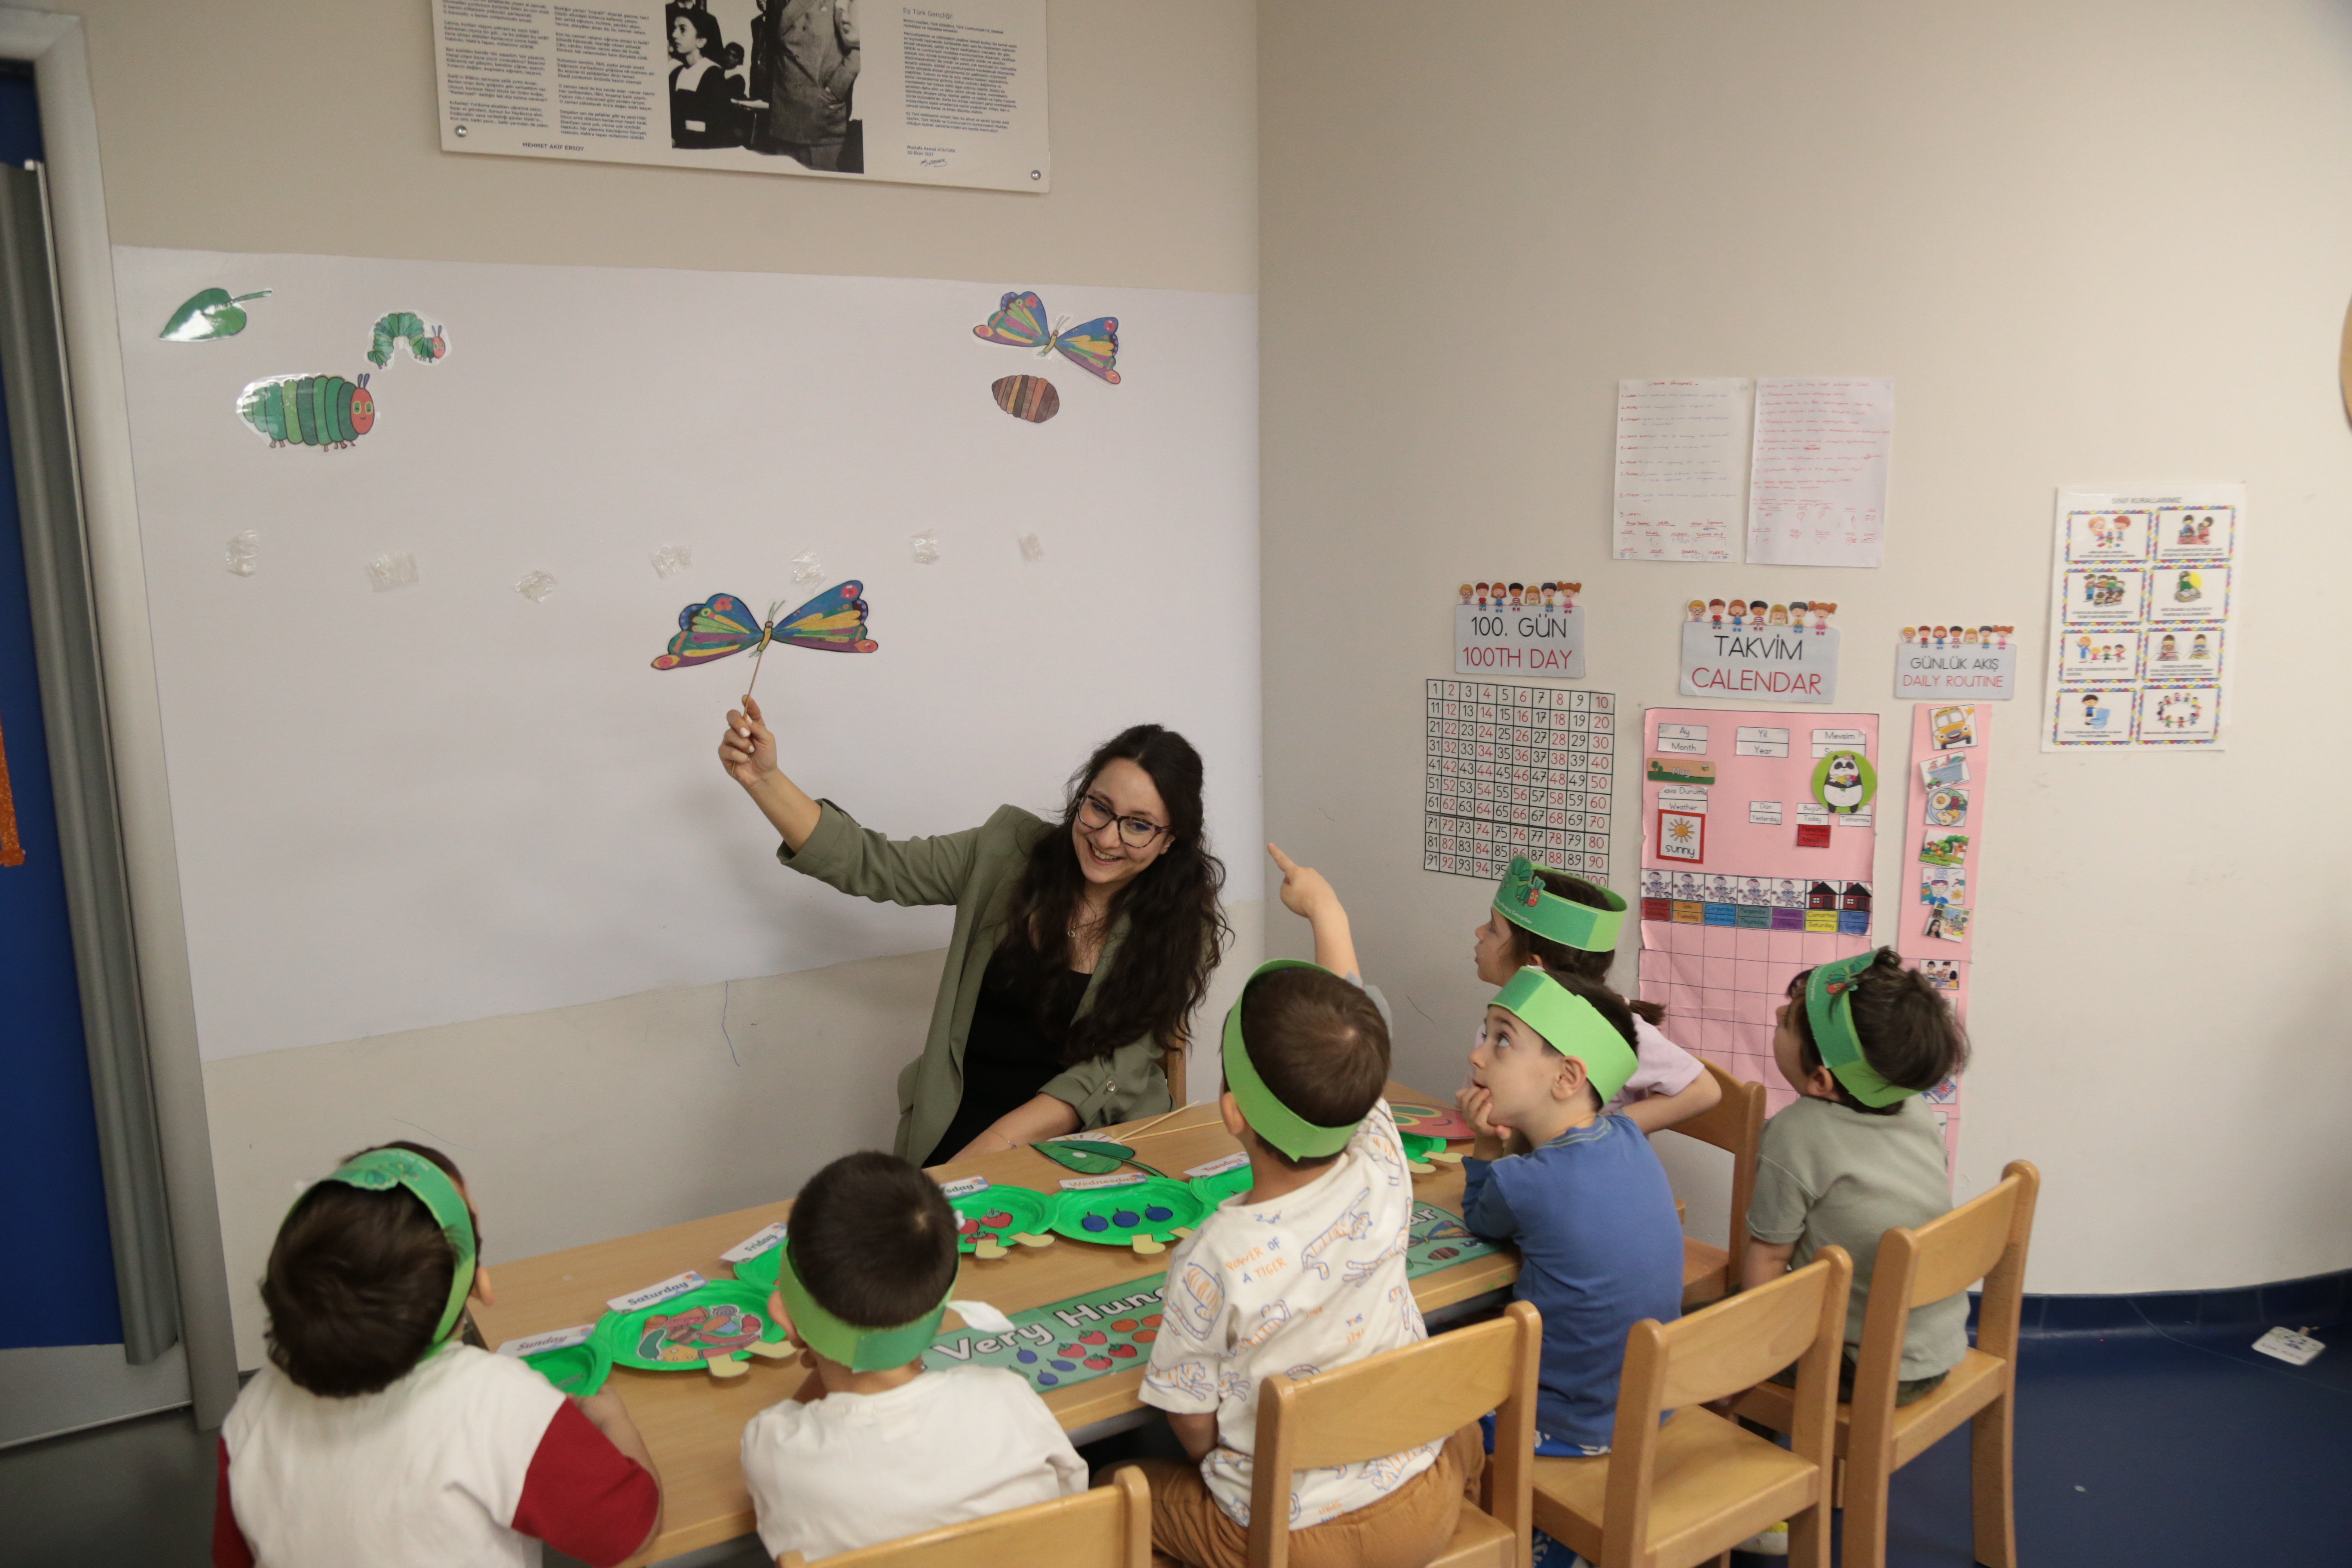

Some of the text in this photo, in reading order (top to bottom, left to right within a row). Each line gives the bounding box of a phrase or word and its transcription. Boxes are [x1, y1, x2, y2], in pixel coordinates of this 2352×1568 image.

[928, 11, 953, 20] Gençliği!
[1471, 613, 1566, 638] 100. GÜN
[1463, 646, 1572, 669] 100TH DAY
[1714, 634, 1803, 661] TAKVİM
[1911, 655, 1999, 672] GÜNLÜK AKIŞ
[1692, 667, 1821, 695] CALENDAR
[1903, 675, 2003, 687] DAILY ROUTINE
[1433, 683, 1609, 709] 1 2 3 4 5 6 7 8 9 10
[1431, 701, 1610, 729] 11 12 13 14 15 16 17 18 19 20
[1430, 720, 1609, 749] 21 22 23 24 25 26 27 28 29 30
[1680, 727, 1690, 737] Ay
[1429, 739, 1609, 769] 31 32 33 34 35 36 37 38 39 40
[1672, 743, 1696, 751] Month
[1754, 746, 1773, 754] Year
[1428, 758, 1607, 789] 41 42 43 44 45 46 47 48 49 50
[1672, 768, 1690, 778] May
[1428, 777, 1606, 809] 51 52 53 54 55 56 57 58 59 60
[1428, 796, 1605, 829] 61 62 63 64 65 66 67 68 69 70
[1752, 815, 1779, 824] Yesterday
[1428, 817, 1605, 849] 71 72 73 74 75 76 77 78 79 80
[1427, 836, 1437, 848] 81
[1442, 838, 1454, 850] 82
[1458, 840, 1471, 852] 83
[1476, 842, 1490, 855] 84
[1494, 845, 1507, 858] 85
[1531, 849, 1544, 861] 87
[1549, 851, 1562, 864] 88
[1568, 853, 1581, 866] 89
[1589, 856, 1604, 869] 90
[1666, 845, 1695, 858] sunny
[1427, 854, 1437, 866] 91
[1442, 856, 1454, 869] 92
[1458, 858, 1470, 871] 93
[1476, 861, 1490, 874] 94
[1677, 913, 1698, 921] Tuesday
[1809, 921, 1834, 930] Saturday
[1202, 1158, 1243, 1172] Tuesday
[946, 1184, 974, 1193] sday
[1069, 1176, 1138, 1187] Wednesday
[744, 1234, 778, 1252] Friday
[1225, 1237, 1280, 1271] POWER OF
[1243, 1257, 1287, 1284] A TIGER
[628, 1281, 689, 1305] Saturday
[517, 1335, 567, 1351] Sunday
[930, 1323, 1055, 1361] Very
